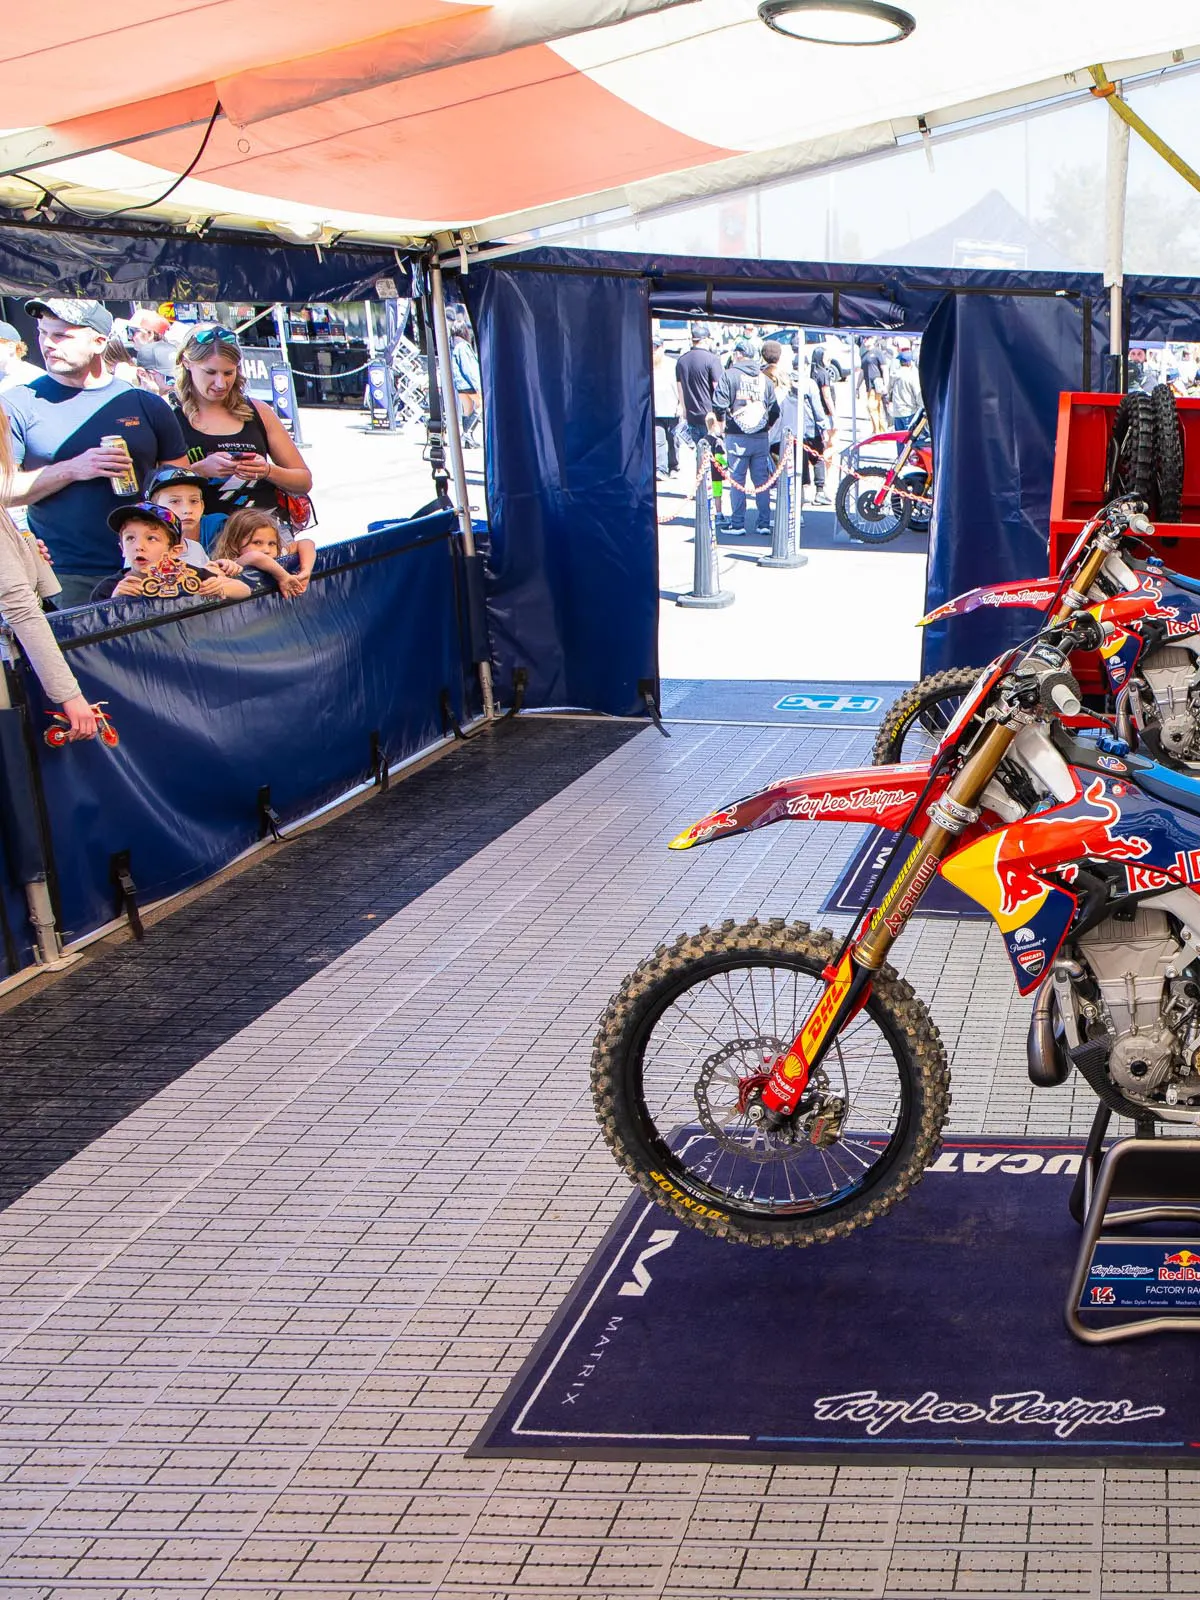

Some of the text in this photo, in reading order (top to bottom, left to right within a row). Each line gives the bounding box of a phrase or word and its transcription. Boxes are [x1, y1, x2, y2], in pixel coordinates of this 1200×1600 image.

[982, 589, 1055, 607] Troy Lee Designs
[1167, 611, 1200, 637] Red
[786, 788, 916, 820] Troy Lee Designs
[899, 853, 940, 914] SHOWA
[1125, 849, 1190, 894] Red
[1020, 952, 1042, 961] DUCATI
[807, 984, 846, 1042] DHL
[922, 1152, 1083, 1175] UCAT
[649, 1170, 724, 1221] DUNLOP
[1090, 1264, 1154, 1277] Troy Lee Designs
[1158, 1267, 1185, 1281] Red
[1090, 1286, 1116, 1305] 14
[1145, 1286, 1186, 1295] FACTORY
[561, 1316, 624, 1404] MATRIX
[813, 1390, 1166, 1436] Troy Lee Designs
